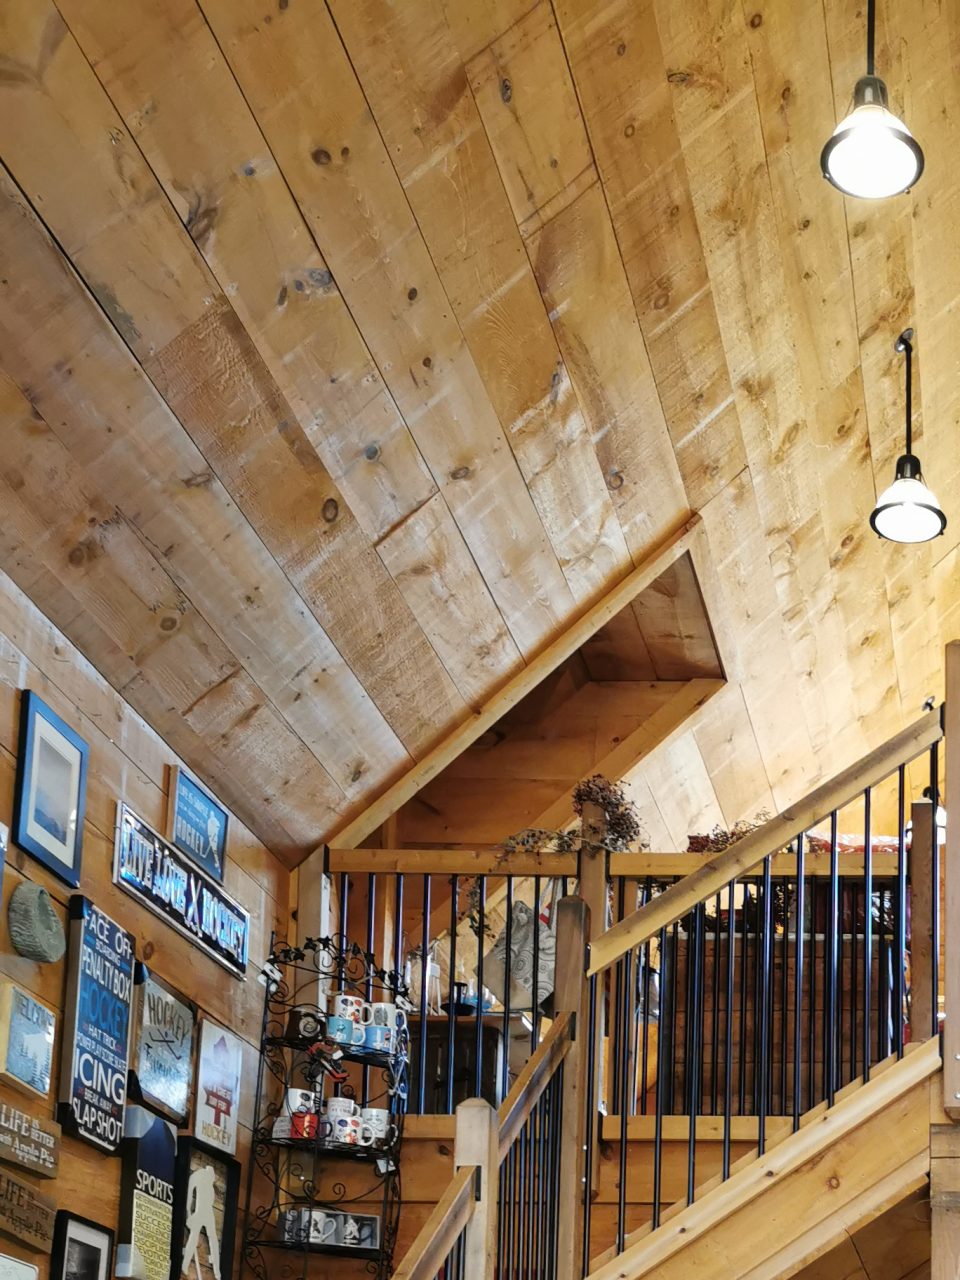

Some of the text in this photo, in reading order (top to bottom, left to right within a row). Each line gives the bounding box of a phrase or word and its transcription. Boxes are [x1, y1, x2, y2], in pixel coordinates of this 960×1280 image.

[84, 910, 132, 960] FACE OFF
[81, 944, 131, 1003] PENALTY BOX
[79, 977, 130, 1032] HOCKEY
[147, 992, 190, 1047] HOCKEY
[88, 1023, 101, 1040] HAT
[74, 1048, 125, 1104] ICING
[0, 1104, 31, 1136] LIFE
[72, 1097, 123, 1143] SLAP SHOT
[201, 1119, 233, 1148] HOCKEY
[12, 1137, 55, 1168] Apple Pie
[136, 1168, 174, 1205] SPORTS
[135, 1210, 172, 1232] SUCCESS
